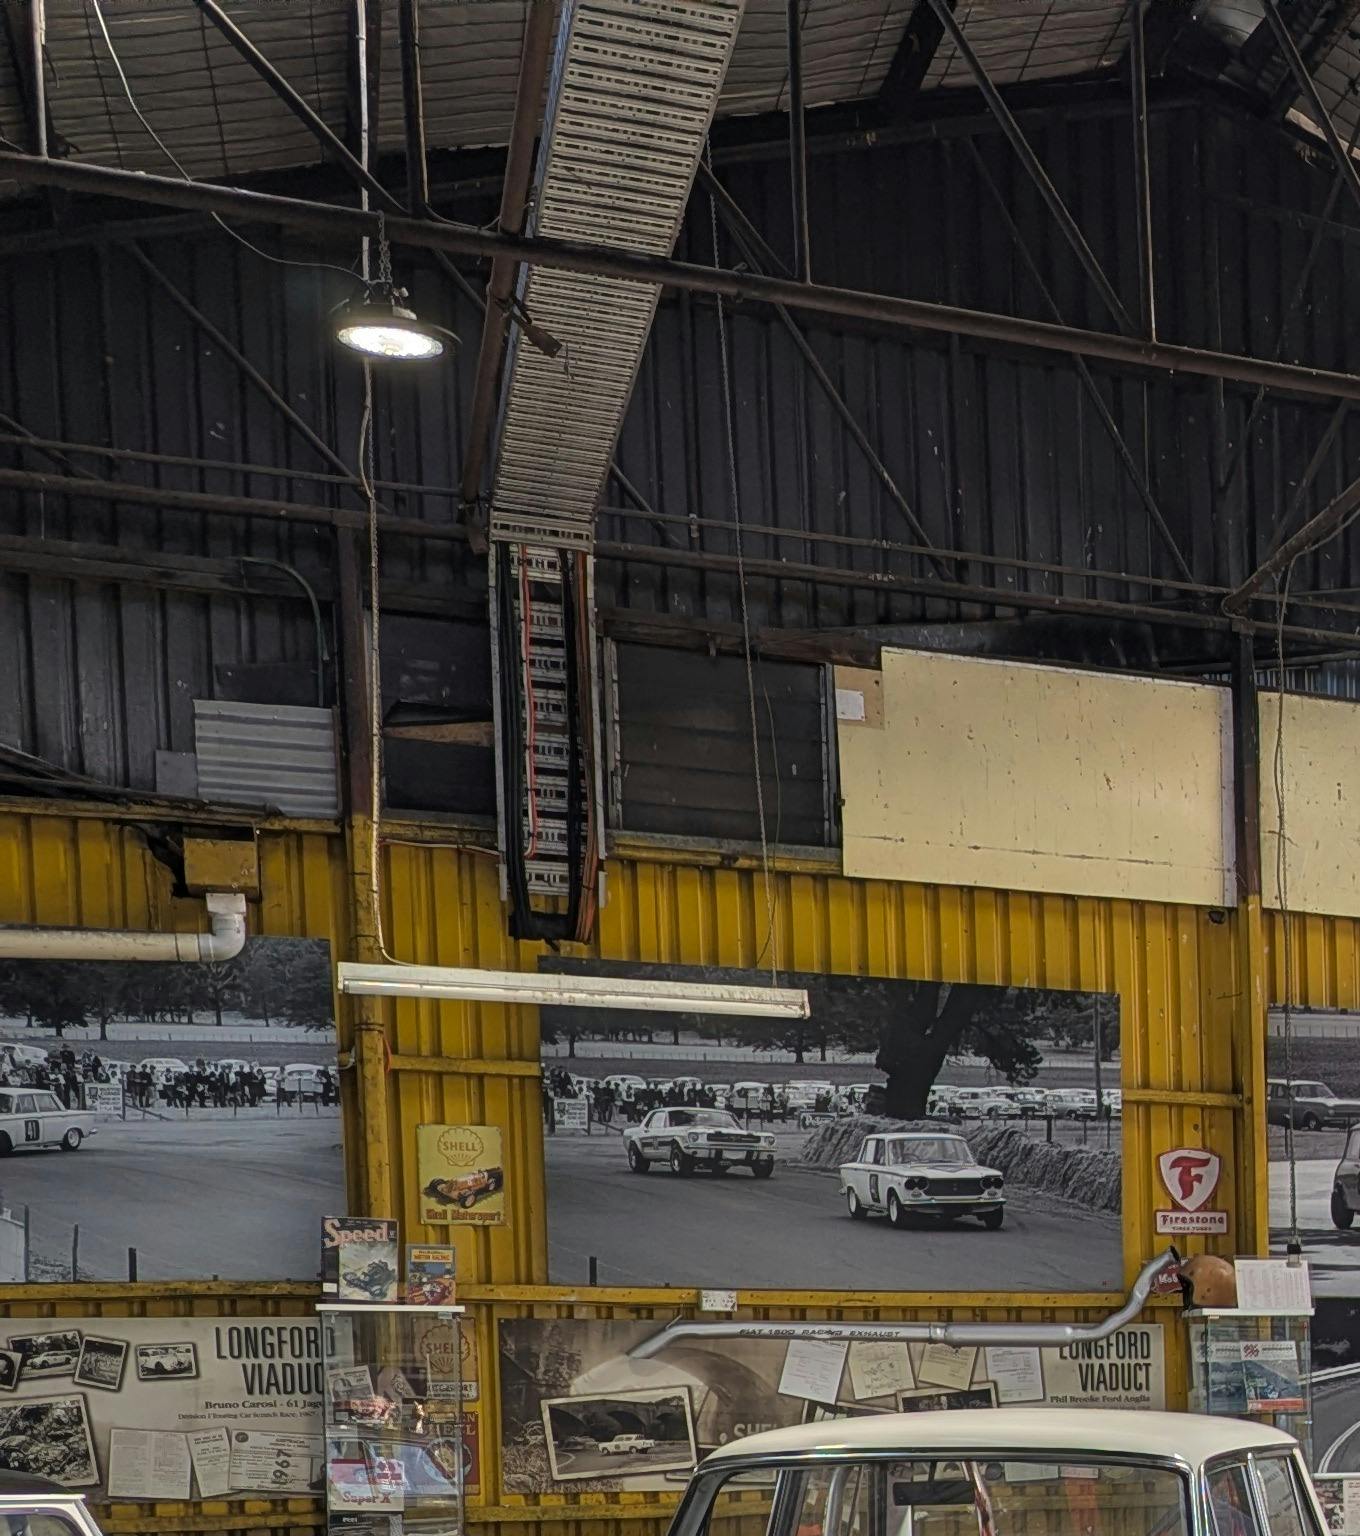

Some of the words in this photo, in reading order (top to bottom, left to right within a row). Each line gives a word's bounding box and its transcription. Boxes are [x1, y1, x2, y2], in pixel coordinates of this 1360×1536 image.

[443, 1141, 479, 1152] SHELL
[1161, 1214, 1224, 1225] Firestone
[324, 1219, 388, 1248] Speed
[1159, 1273, 1179, 1284] Mob
[215, 1326, 335, 1359] LONGFORD
[242, 1363, 323, 1395] VIADUC
[1079, 1363, 1151, 1391] VIADUCT
[205, 1401, 239, 1409] Bruno
[242, 1400, 278, 1408] Carosi
[287, 1399, 299, 1408] 61
[301, 1400, 322, 1410] Jag
